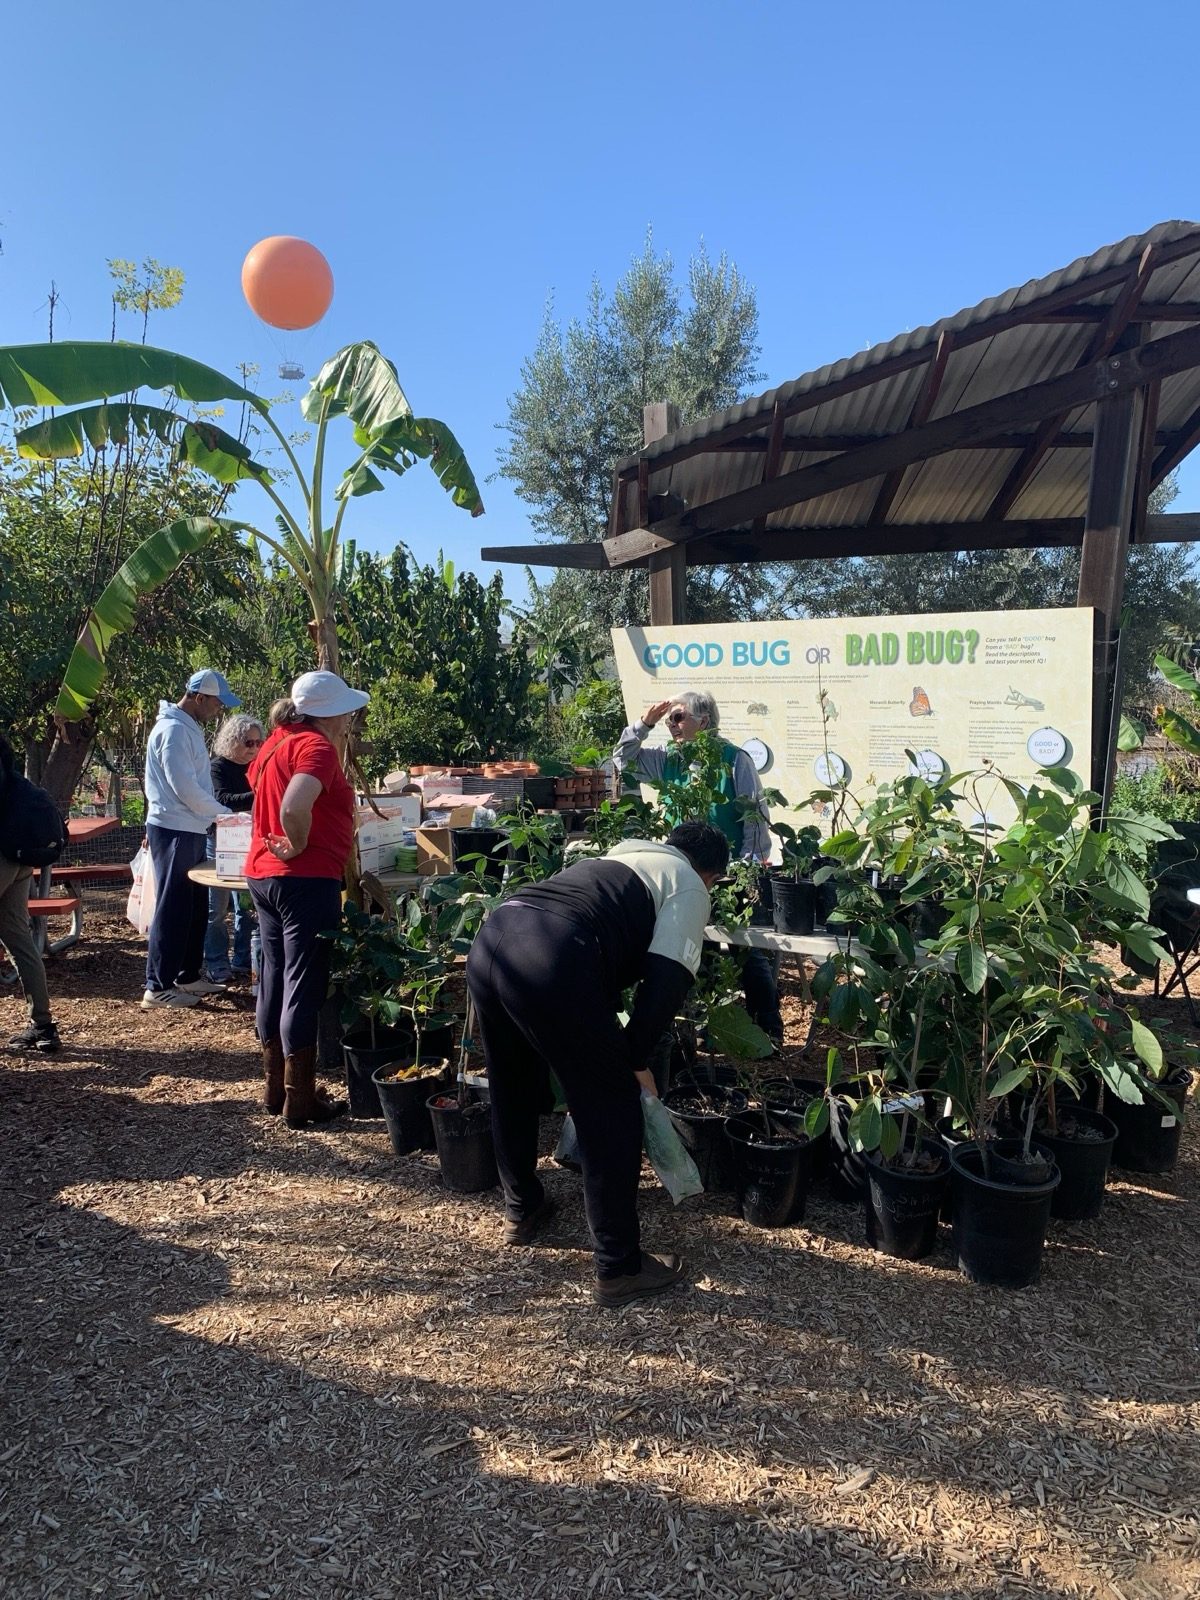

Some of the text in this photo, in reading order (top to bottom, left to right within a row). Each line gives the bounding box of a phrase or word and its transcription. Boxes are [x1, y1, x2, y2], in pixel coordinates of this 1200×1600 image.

[643, 629, 980, 669] GOOD BUG OR BAD BUG?
